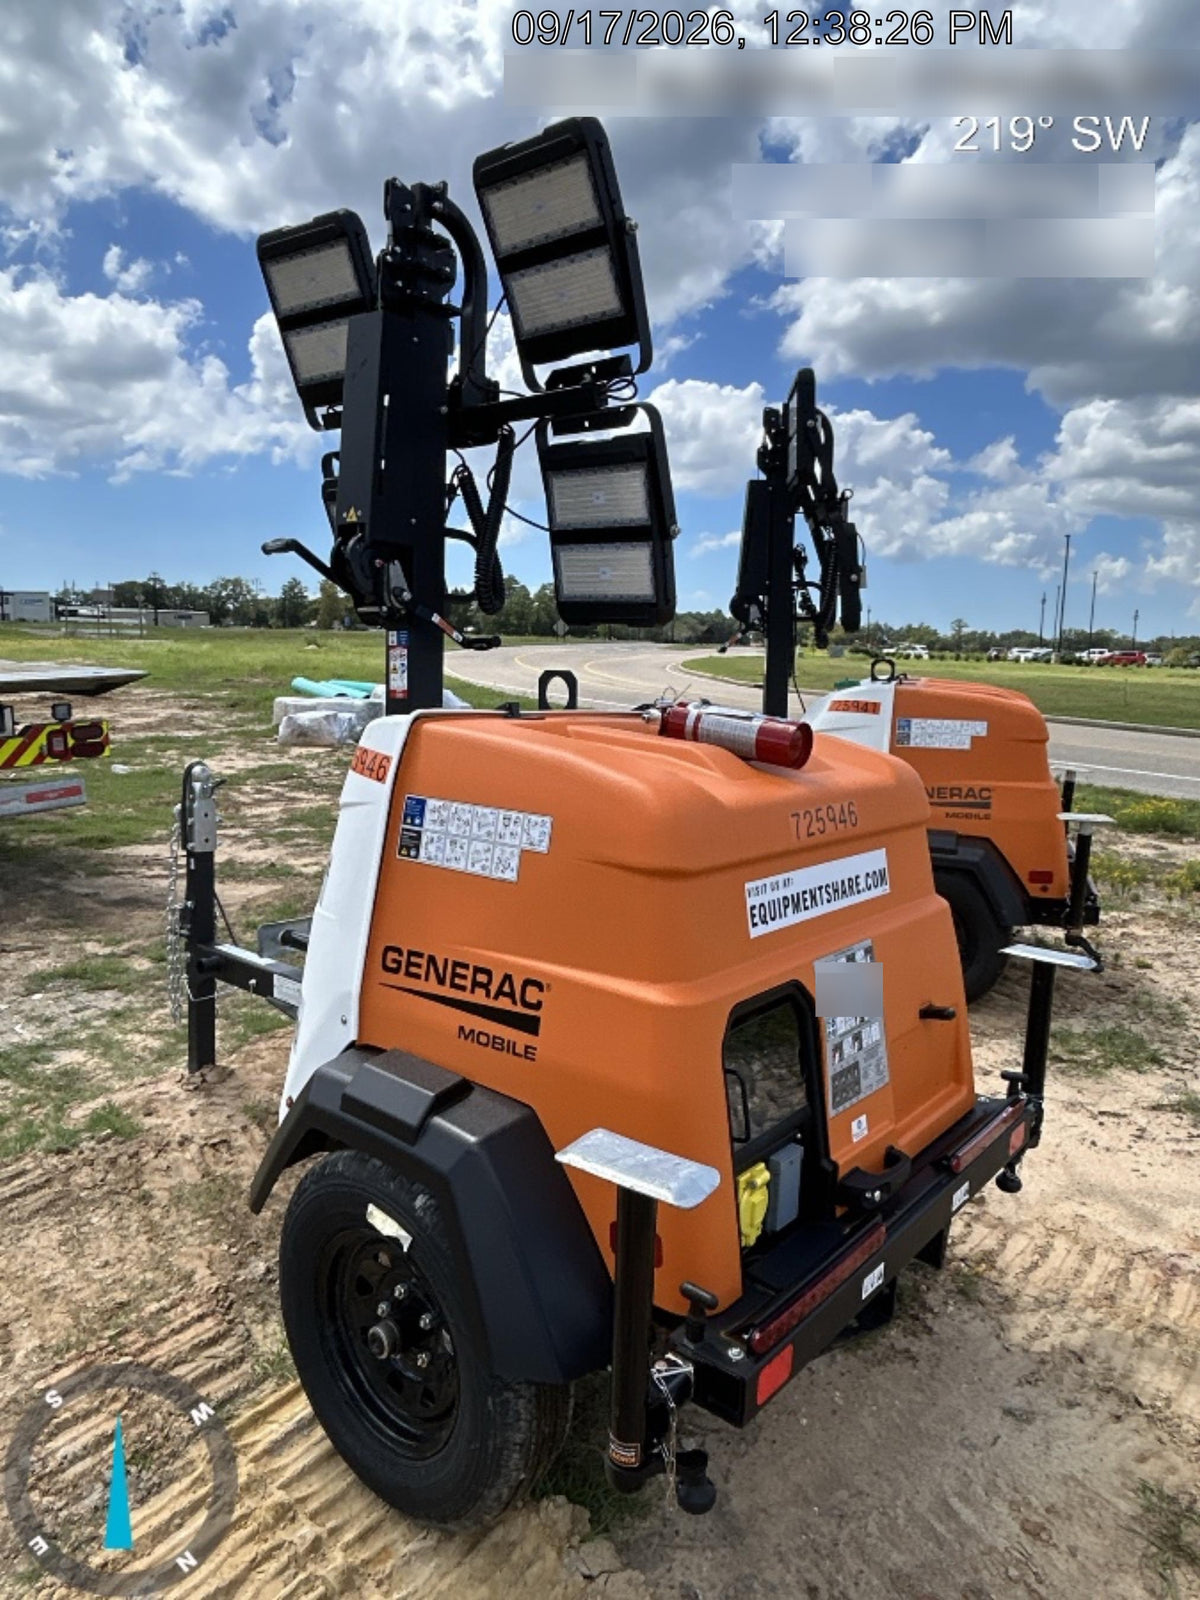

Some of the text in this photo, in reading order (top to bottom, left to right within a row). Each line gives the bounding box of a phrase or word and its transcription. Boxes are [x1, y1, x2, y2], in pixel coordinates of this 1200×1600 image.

[790, 801, 859, 840] 725946
[747, 882, 768, 898] VISIT
[750, 866, 888, 928] EQUIPMENTSHARE.COM
[381, 945, 545, 1012] GENERAC
[457, 1024, 538, 1063] MOBILE
